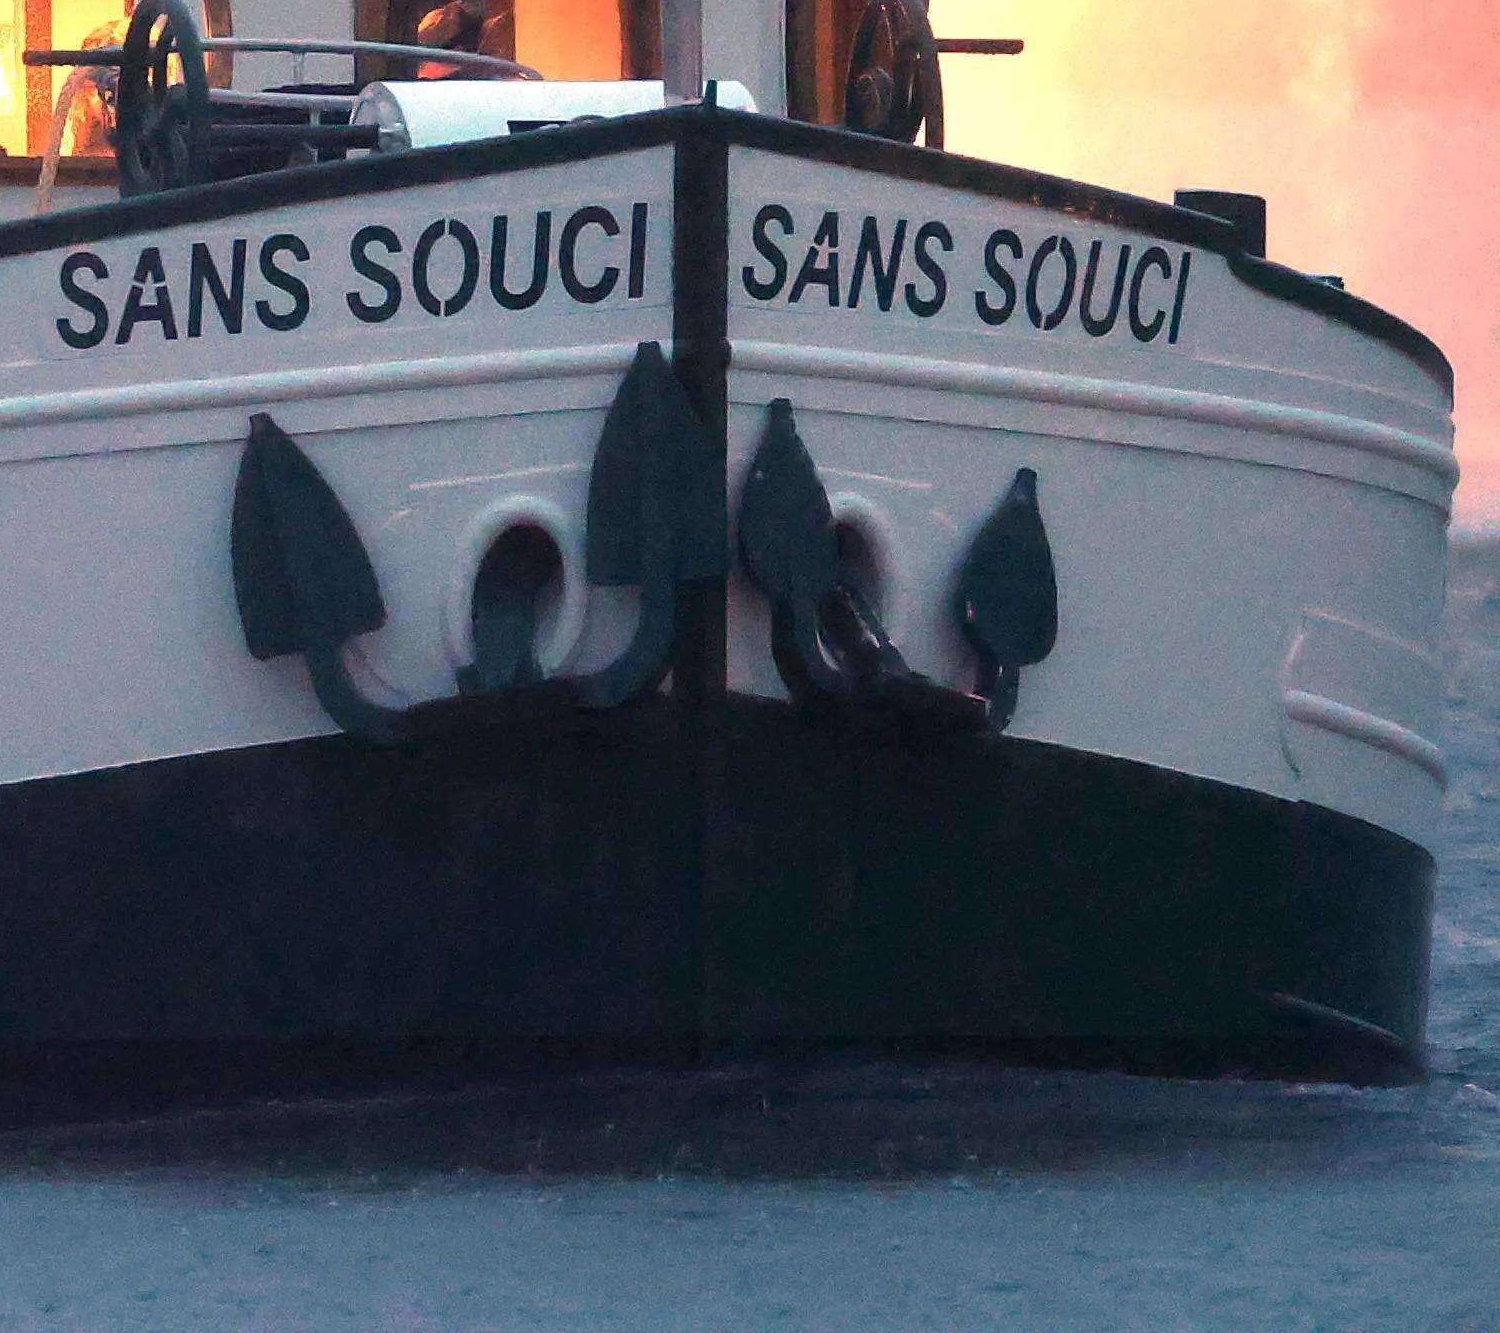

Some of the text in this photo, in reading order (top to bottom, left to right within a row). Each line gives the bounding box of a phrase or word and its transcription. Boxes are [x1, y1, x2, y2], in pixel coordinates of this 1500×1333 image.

[55, 201, 649, 351] SANS SOUCI
[740, 202, 1193, 346] SANS SOUCI
